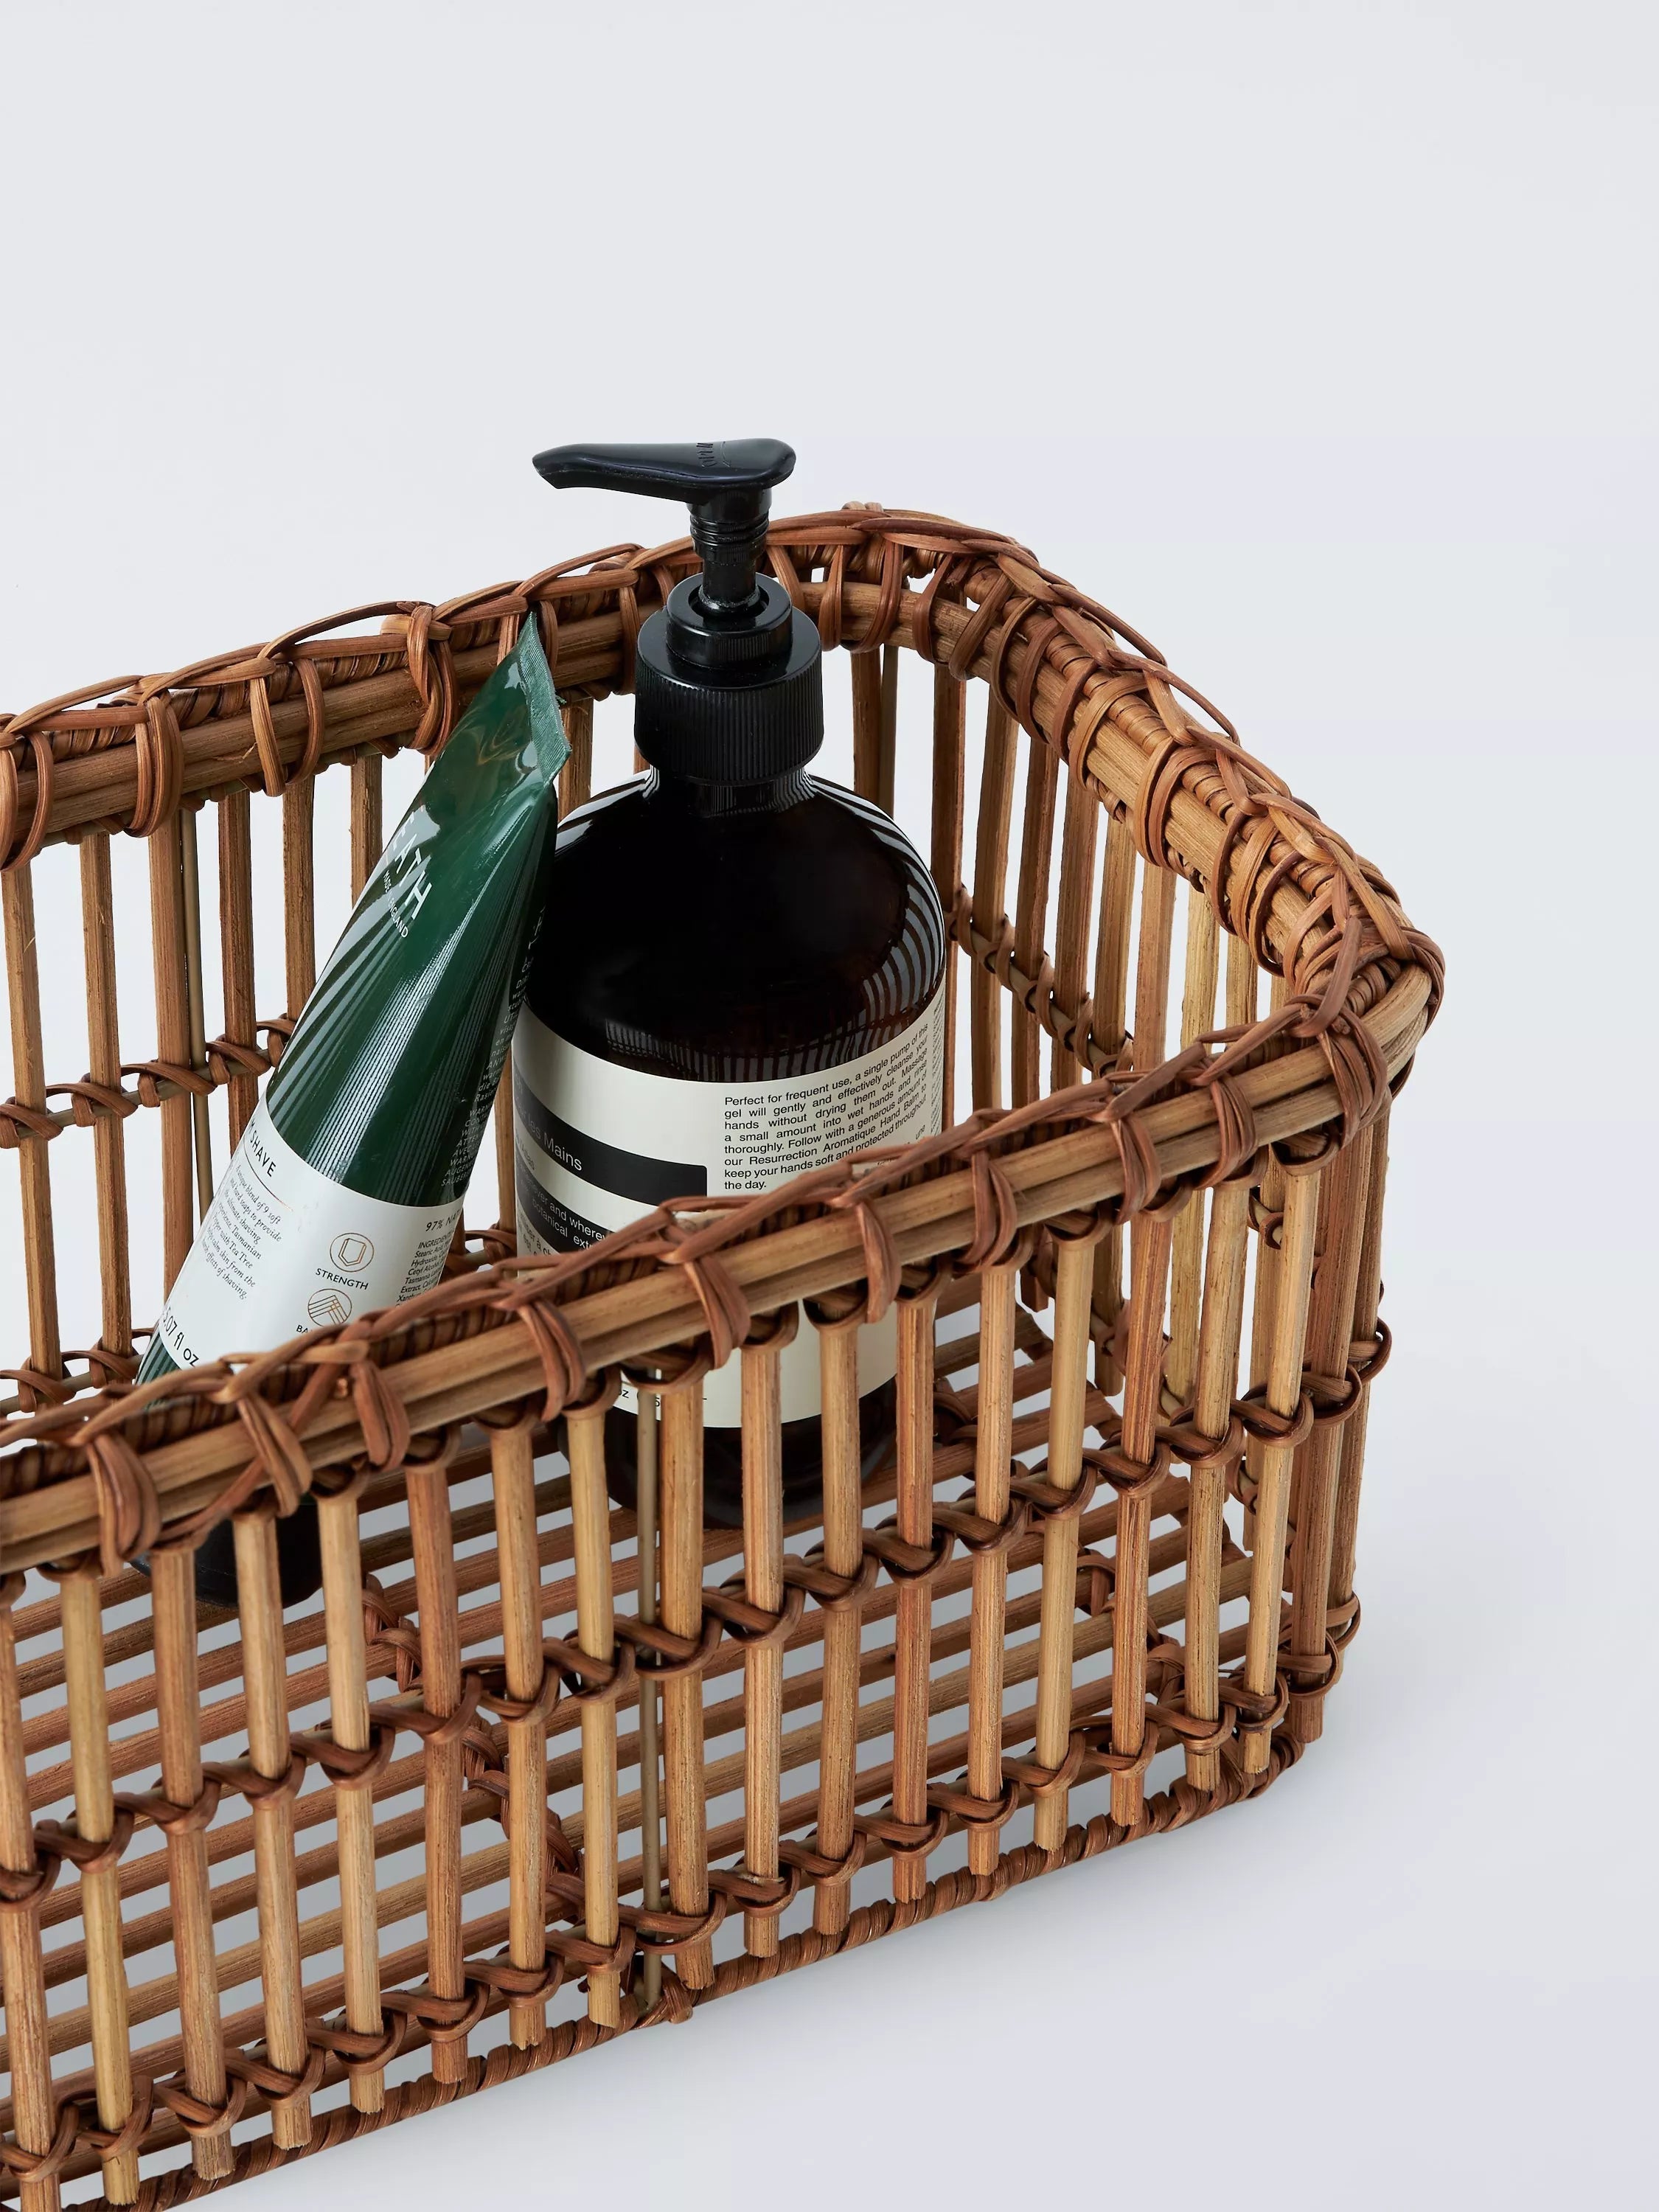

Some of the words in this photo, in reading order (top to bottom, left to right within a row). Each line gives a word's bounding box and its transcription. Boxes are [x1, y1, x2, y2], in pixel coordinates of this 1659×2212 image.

[724, 1109, 742, 1119] gel
[749, 1107, 766, 1116] will
[773, 1102, 806, 1116] gently
[813, 1094, 832, 1107] and
[838, 1074, 883, 1100] effectively
[886, 1051, 914, 1077] cleanse
[917, 1034, 928, 1055] your
[725, 1096, 764, 1105] Perfect
[768, 1094, 782, 1103] for
[786, 1083, 829, 1099] frequent
[832, 1078, 852, 1090] use,
[855, 1073, 861, 1081] a
[863, 1059, 888, 1077] single
[890, 1043, 911, 1064] pump
[911, 1033, 918, 1045] of
[919, 1023, 928, 1038] this
[724, 1142, 784, 1154] thoroughly.
[788, 1135, 822, 1148] Follow
[825, 1127, 845, 1139] with
[848, 1124, 855, 1132] a
[858, 1102, 896, 1130] generous
[897, 1078, 921, 1105] amount
[922, 1068, 927, 1081] of
[725, 1121, 759, 1130] hands
[768, 1113, 807, 1127] without
[815, 1103, 846, 1119] drying
[854, 1090, 876, 1106] them
[882, 1077, 897, 1091] out.
[902, 1048, 928, 1078] Massage
[740, 1131, 768, 1141] small
[776, 1123, 816, 1138] amount
[823, 1117, 841, 1128] into
[847, 1107, 863, 1120] wet
[869, 1091, 894, 1110] hands
[898, 1075, 911, 1092] and
[914, 1060, 927, 1078] rinse
[528, 1113, 541, 1139] les
[544, 1132, 582, 1172] Mains
[724, 1169, 751, 1179] keep
[754, 1167, 779, 1178] your
[781, 1161, 813, 1173] hands
[815, 1154, 834, 1166] soft
[835, 1146, 854, 1161] and
[855, 1124, 894, 1152] protected
[895, 1093, 926, 1130] throughout
[750, 1148, 818, 1165] Resurrection
[823, 1125, 876, 1152] Aromatique
[880, 1107, 900, 1127] Hand
[903, 1092, 919, 1111] Balm
[921, 1083, 927, 1093] to
[251, 1130, 276, 1178] SHAVE
[246, 1184, 260, 1203] blend
[257, 1202, 266, 1211] of
[268, 1212, 281, 1225] soft
[724, 1180, 742, 1189] the
[745, 1180, 767, 1190] day.
[227, 1197, 241, 1220] ultimate
[240, 1218, 261, 1245] shaving
[240, 1199, 251, 1214] soaps
[250, 1212, 257, 1221] to
[254, 1219, 282, 1242] provide
[425, 1219, 444, 1232] 97%
[532, 1197, 568, 1237] botanical
[550, 1202, 567, 1221] and
[220, 1230, 231, 1245] with
[229, 1241, 240, 1256] Tea
[239, 1251, 253, 1269] Tree
[232, 1225, 262, 1259] Tasmanian
[206, 1252, 218, 1269] effects
[216, 1267, 226, 1277] of
[222, 1273, 247, 1300] shaving.
[219, 1250, 230, 1264] skin
[226, 1261, 244, 1278] from
[243, 1276, 256, 1287] the
[316, 1267, 369, 1290] STRENGTH
[174, 1332, 184, 1351] fl
[183, 1348, 199, 1368] oz
